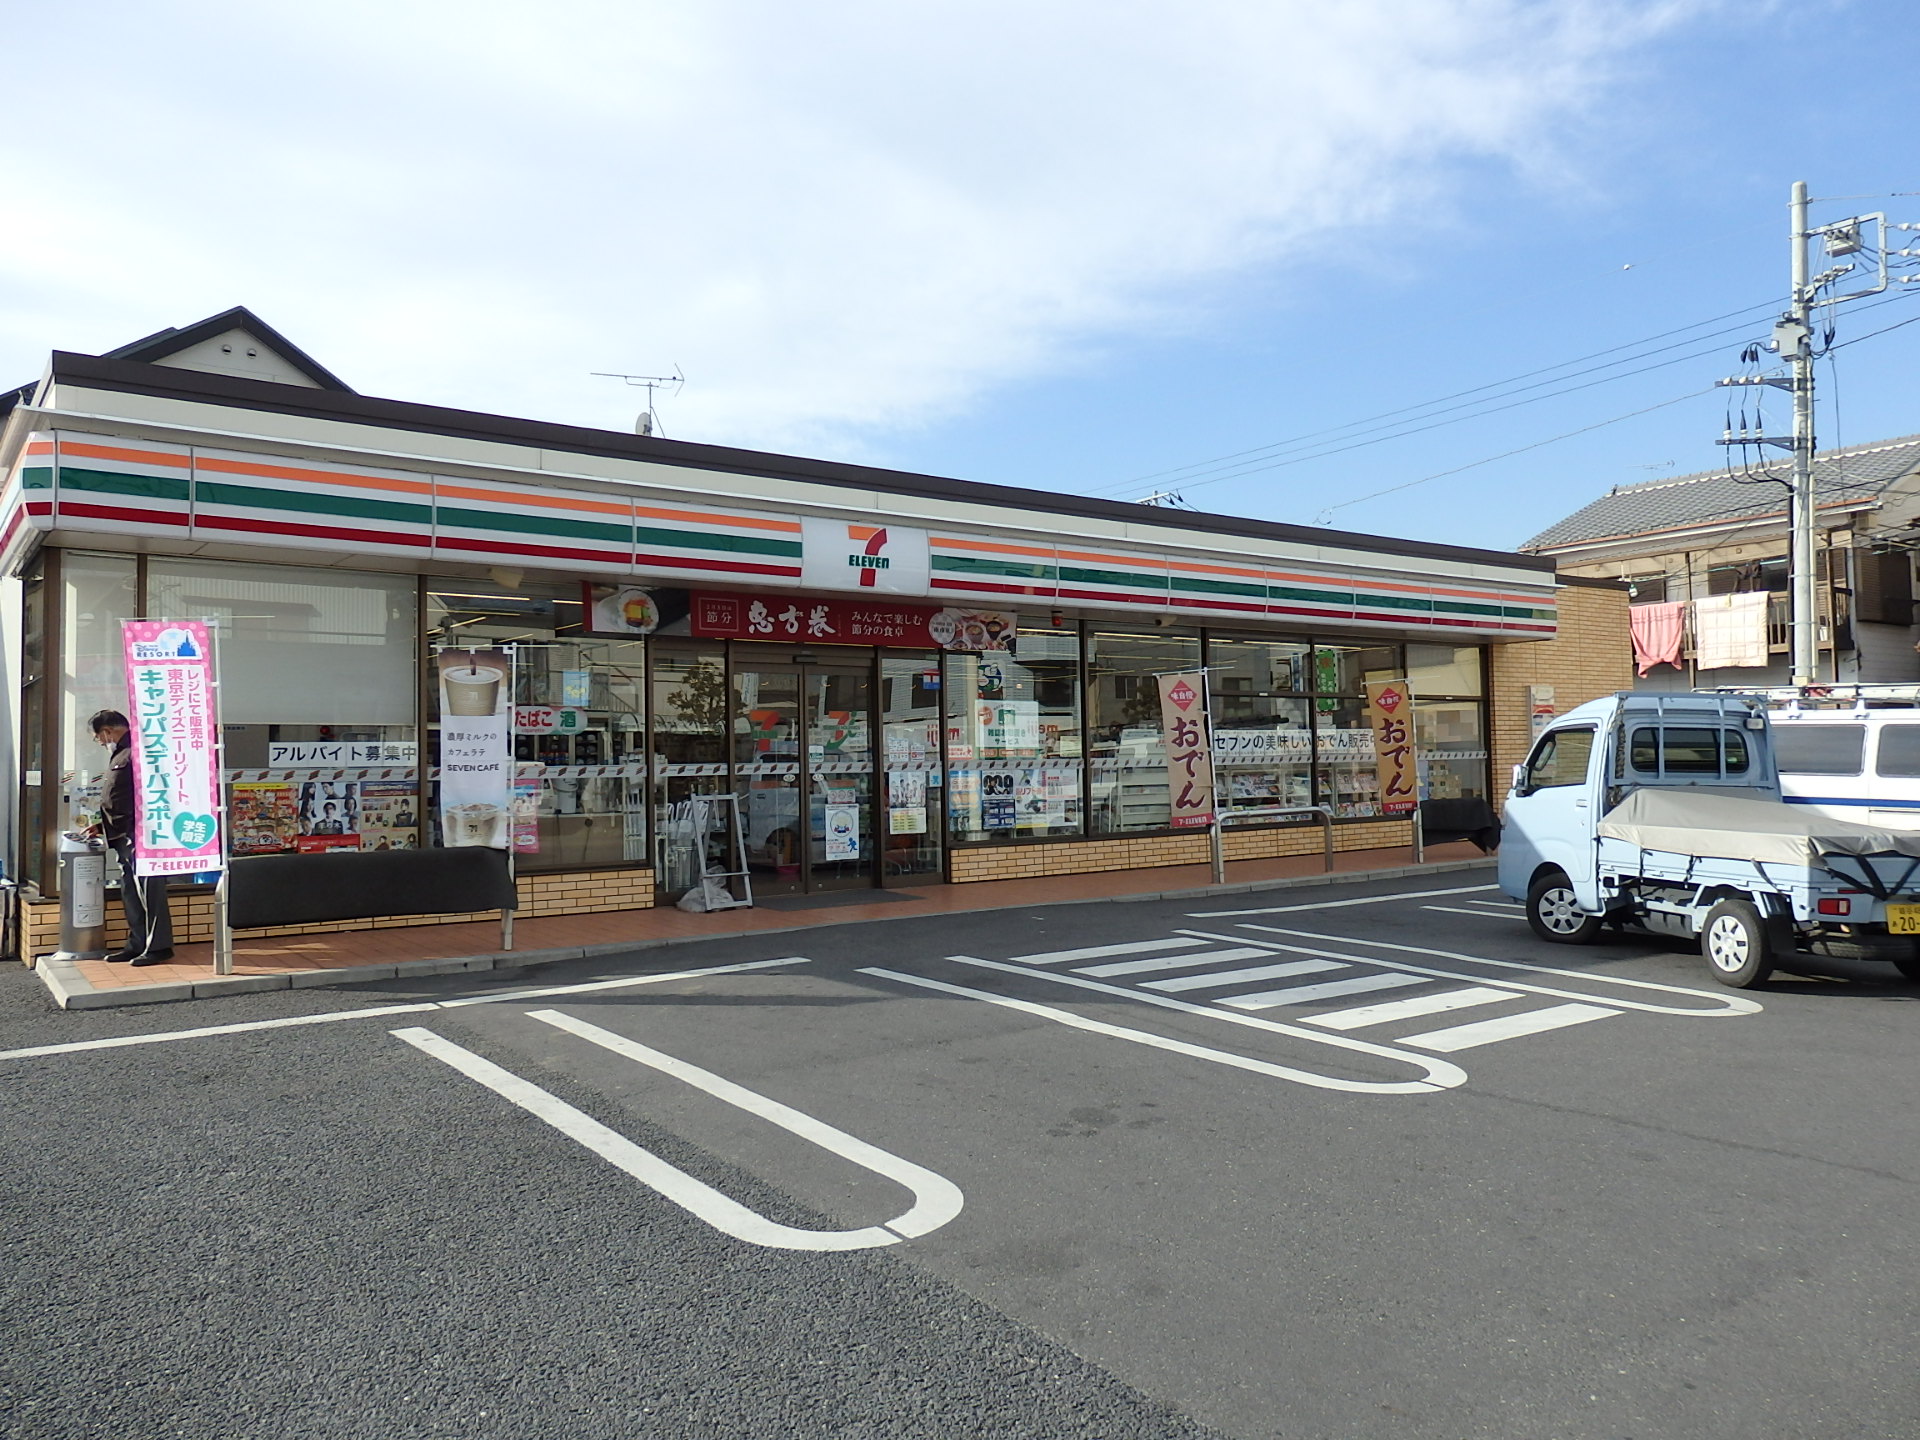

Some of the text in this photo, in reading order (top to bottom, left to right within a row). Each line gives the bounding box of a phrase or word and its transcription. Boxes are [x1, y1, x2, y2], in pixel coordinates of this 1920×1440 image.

[848, 525, 887, 587] 7
[706, 611, 732, 624] 節分
[748, 600, 836, 638] 恵方巻
[851, 611, 923, 627] みんなで楽しむ
[851, 623, 904, 638] 節分の食卓
[187, 669, 204, 750] レジにて販売中
[514, 710, 552, 728] たばこ
[560, 710, 576, 728] 酒
[167, 668, 189, 803] 東京ディズニーリゾート
[447, 731, 497, 742] 濃厚ミルクの
[139, 669, 171, 845] キャンパスデーパスポート
[272, 745, 417, 762] アルバイト募集中
[448, 748, 487, 757] カフェラテ
[1379, 717, 1414, 797] おでん
[447, 764, 476, 772] SEVEN
[1170, 716, 1206, 809] おでん
[183, 820, 207, 833] 学生
[180, 832, 205, 844] 限定
